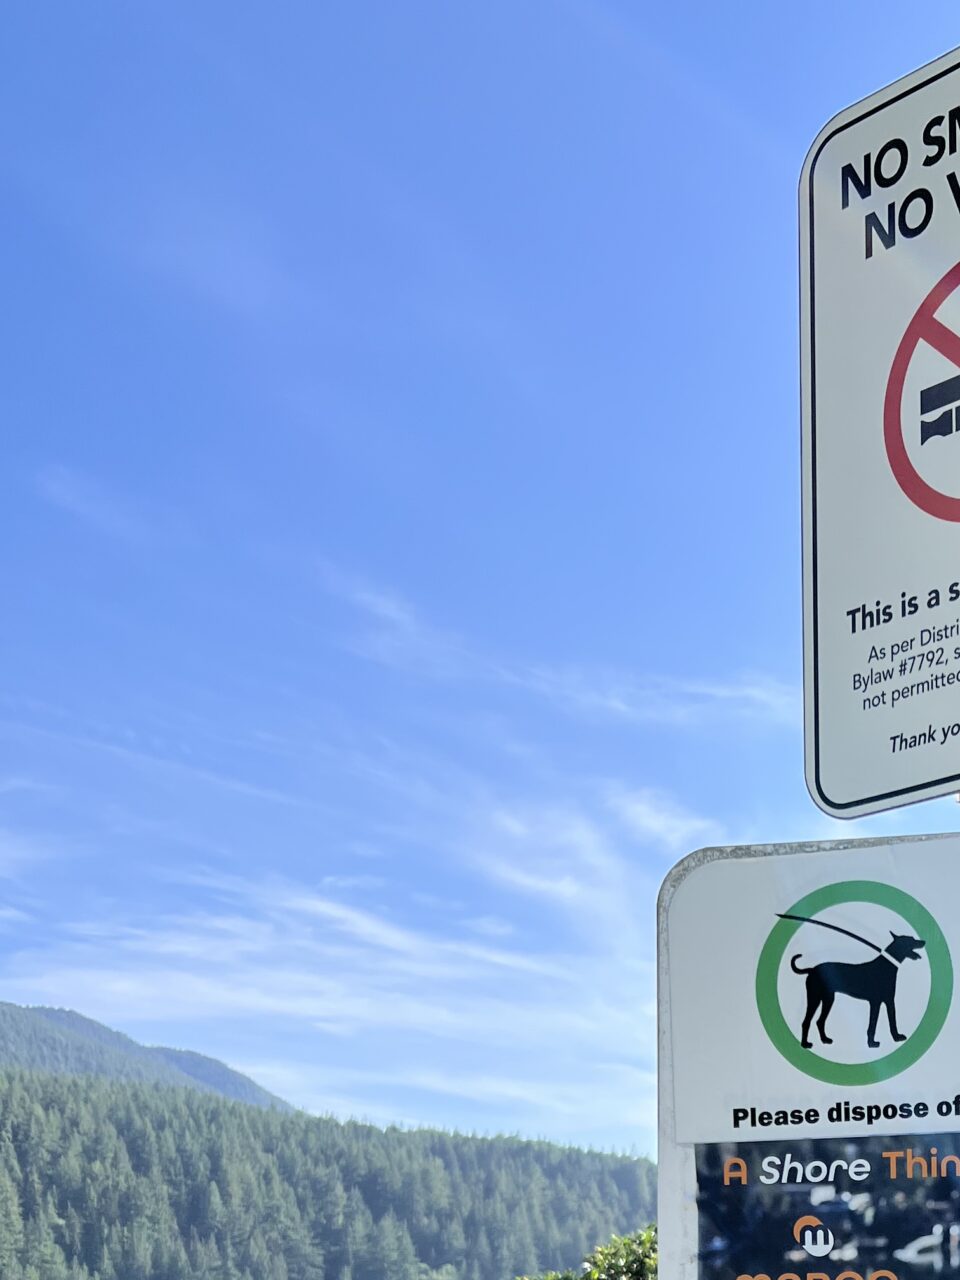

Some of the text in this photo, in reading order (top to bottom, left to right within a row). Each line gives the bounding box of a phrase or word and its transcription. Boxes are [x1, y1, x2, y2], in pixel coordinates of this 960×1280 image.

[841, 138, 909, 210] NO
[865, 187, 934, 259] NO
[846, 602, 893, 634] This
[900, 592, 919, 619] is
[926, 589, 941, 608] a
[867, 645, 886, 664] As
[890, 637, 916, 663] per
[852, 665, 895, 691] Bylaw
[898, 646, 949, 677] #7792,
[862, 690, 887, 711] not
[889, 723, 937, 754] Thank
[733, 1107, 820, 1129] Please
[827, 1101, 929, 1125] dispose
[723, 1157, 748, 1186] A
[759, 1153, 872, 1185] Shore
